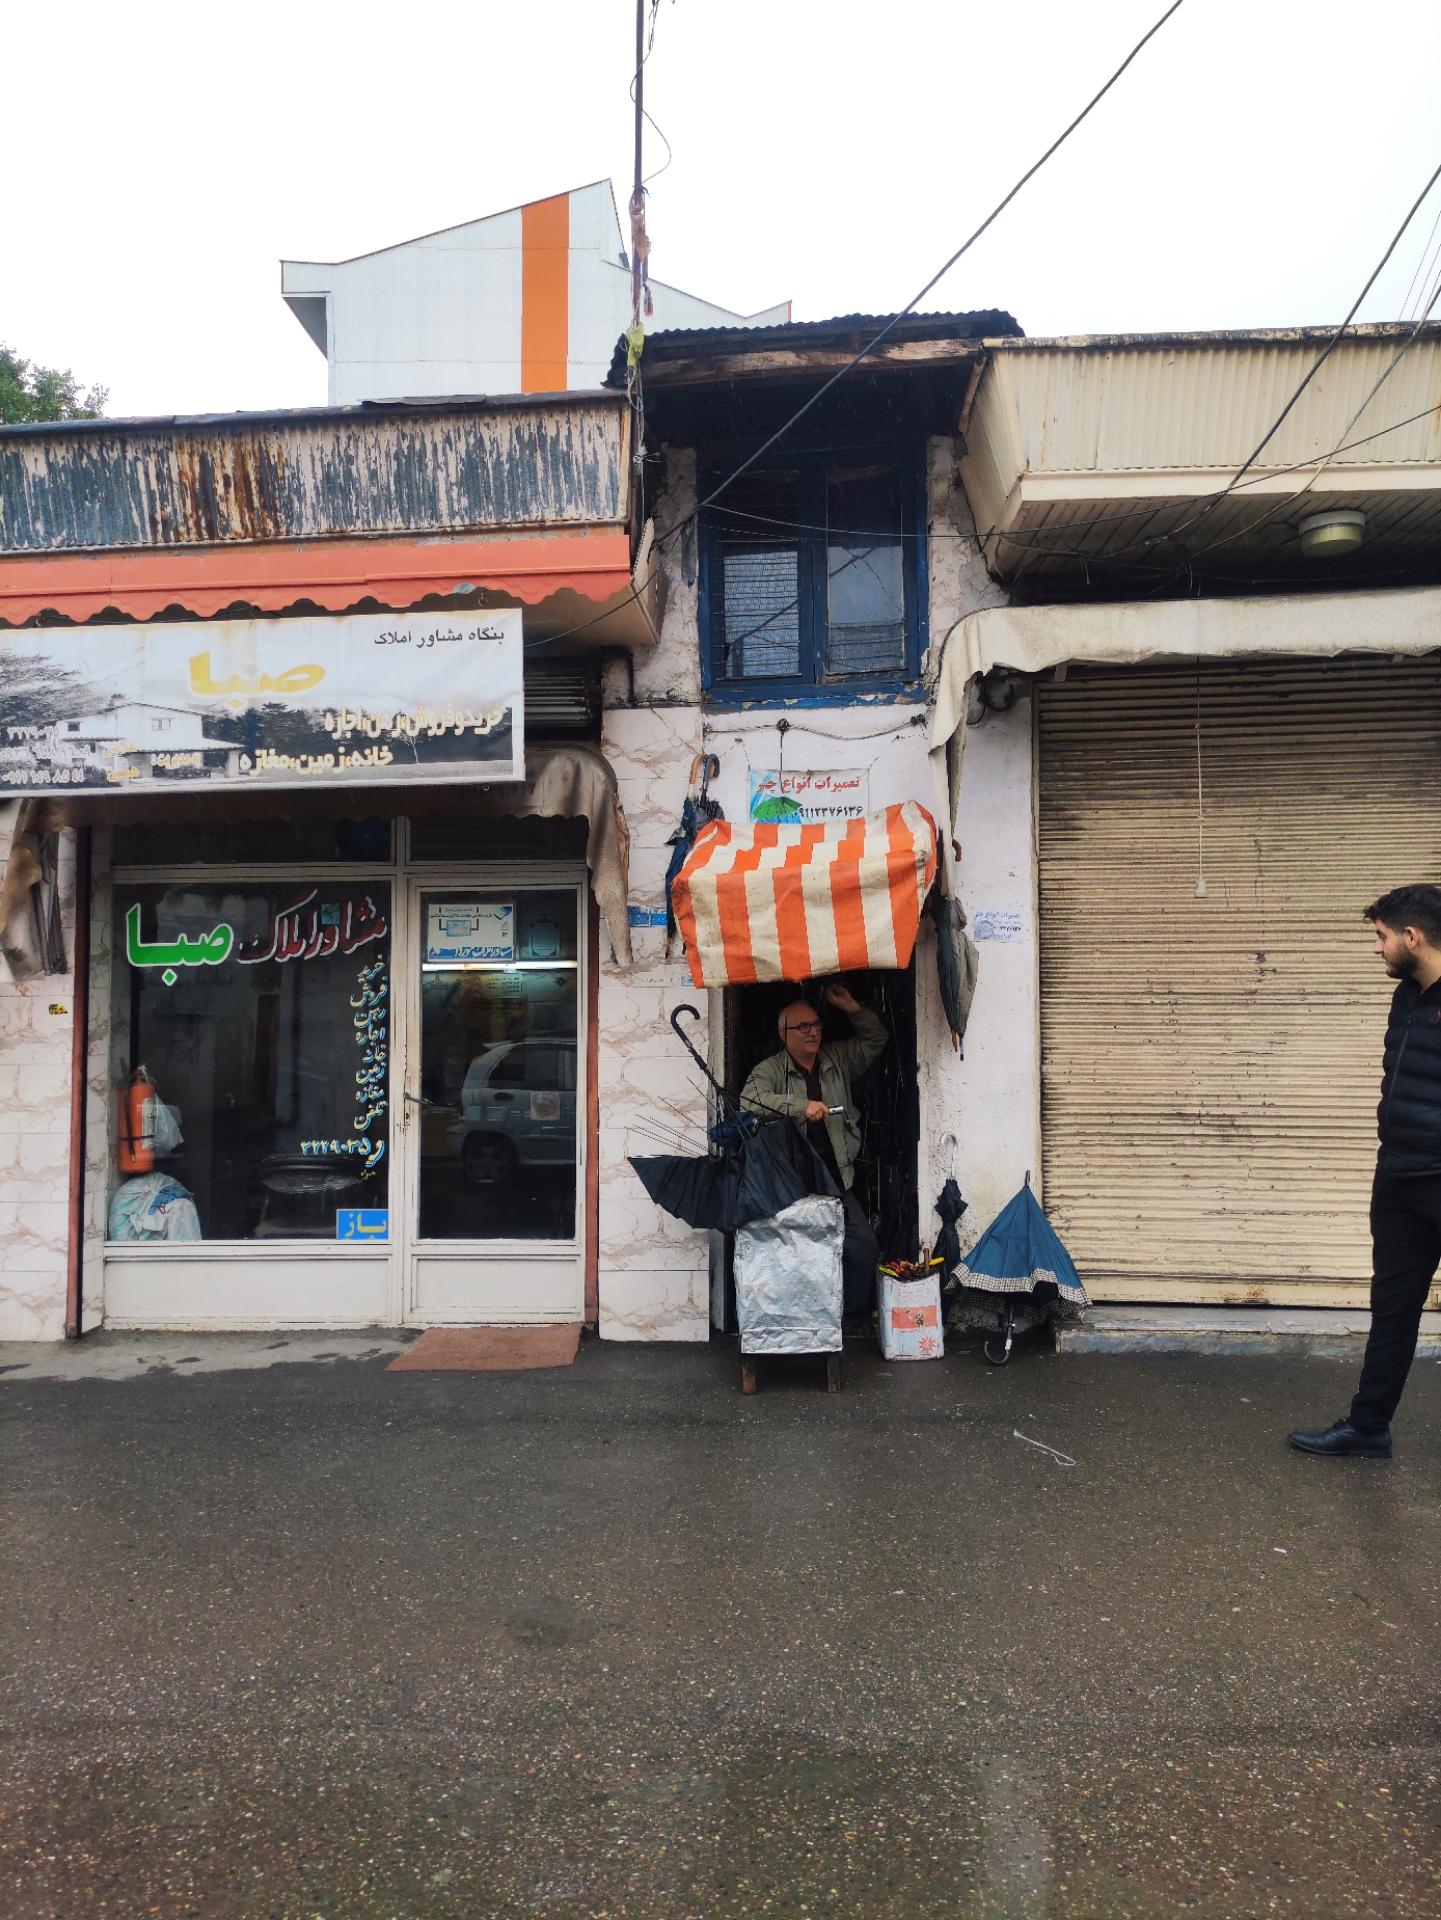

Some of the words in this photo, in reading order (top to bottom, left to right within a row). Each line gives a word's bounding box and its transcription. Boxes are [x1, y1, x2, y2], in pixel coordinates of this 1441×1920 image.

[374, 629, 412, 645] املاک
[416, 628, 463, 648] مشاور
[468, 627, 505, 645] بنگاه
[187, 650, 327, 710] صبا
[814, 775, 861, 793] تعمیرات
[125, 902, 235, 987] صبا
[357, 953, 386, 982] خرید
[349, 975, 388, 1008] فروش
[356, 1026, 386, 1047] اجاره
[361, 1043, 387, 1064] خانه
[355, 1061, 387, 1084] زمین
[353, 1101, 389, 1131] تلفن
